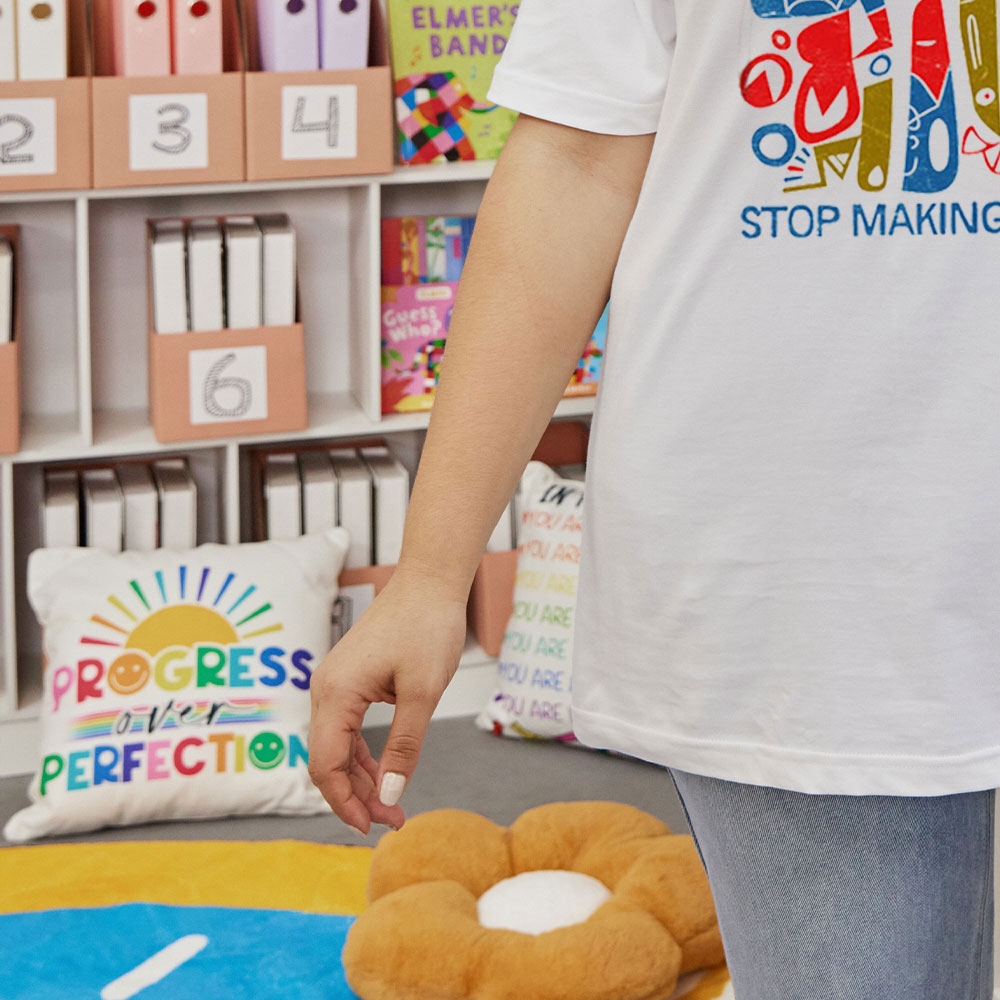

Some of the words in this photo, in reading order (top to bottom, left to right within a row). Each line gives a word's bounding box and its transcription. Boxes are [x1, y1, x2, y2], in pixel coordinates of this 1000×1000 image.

[411, 2, 520, 31] ELMER'S
[430, 34, 508, 59] BAND
[0, 113, 35, 164] 2
[151, 102, 193, 154] 3
[290, 95, 340, 149] 4
[741, 204, 840, 238] STOP
[383, 305, 437, 328] Guess
[388, 319, 442, 343] Who?
[203, 352, 253, 418] 6
[52, 646, 314, 713] PROGRESS
[531, 667, 565, 692] ARE
[116, 698, 246, 736] over
[529, 699, 563, 721] ARE
[39, 731, 311, 797] PERFECTION
